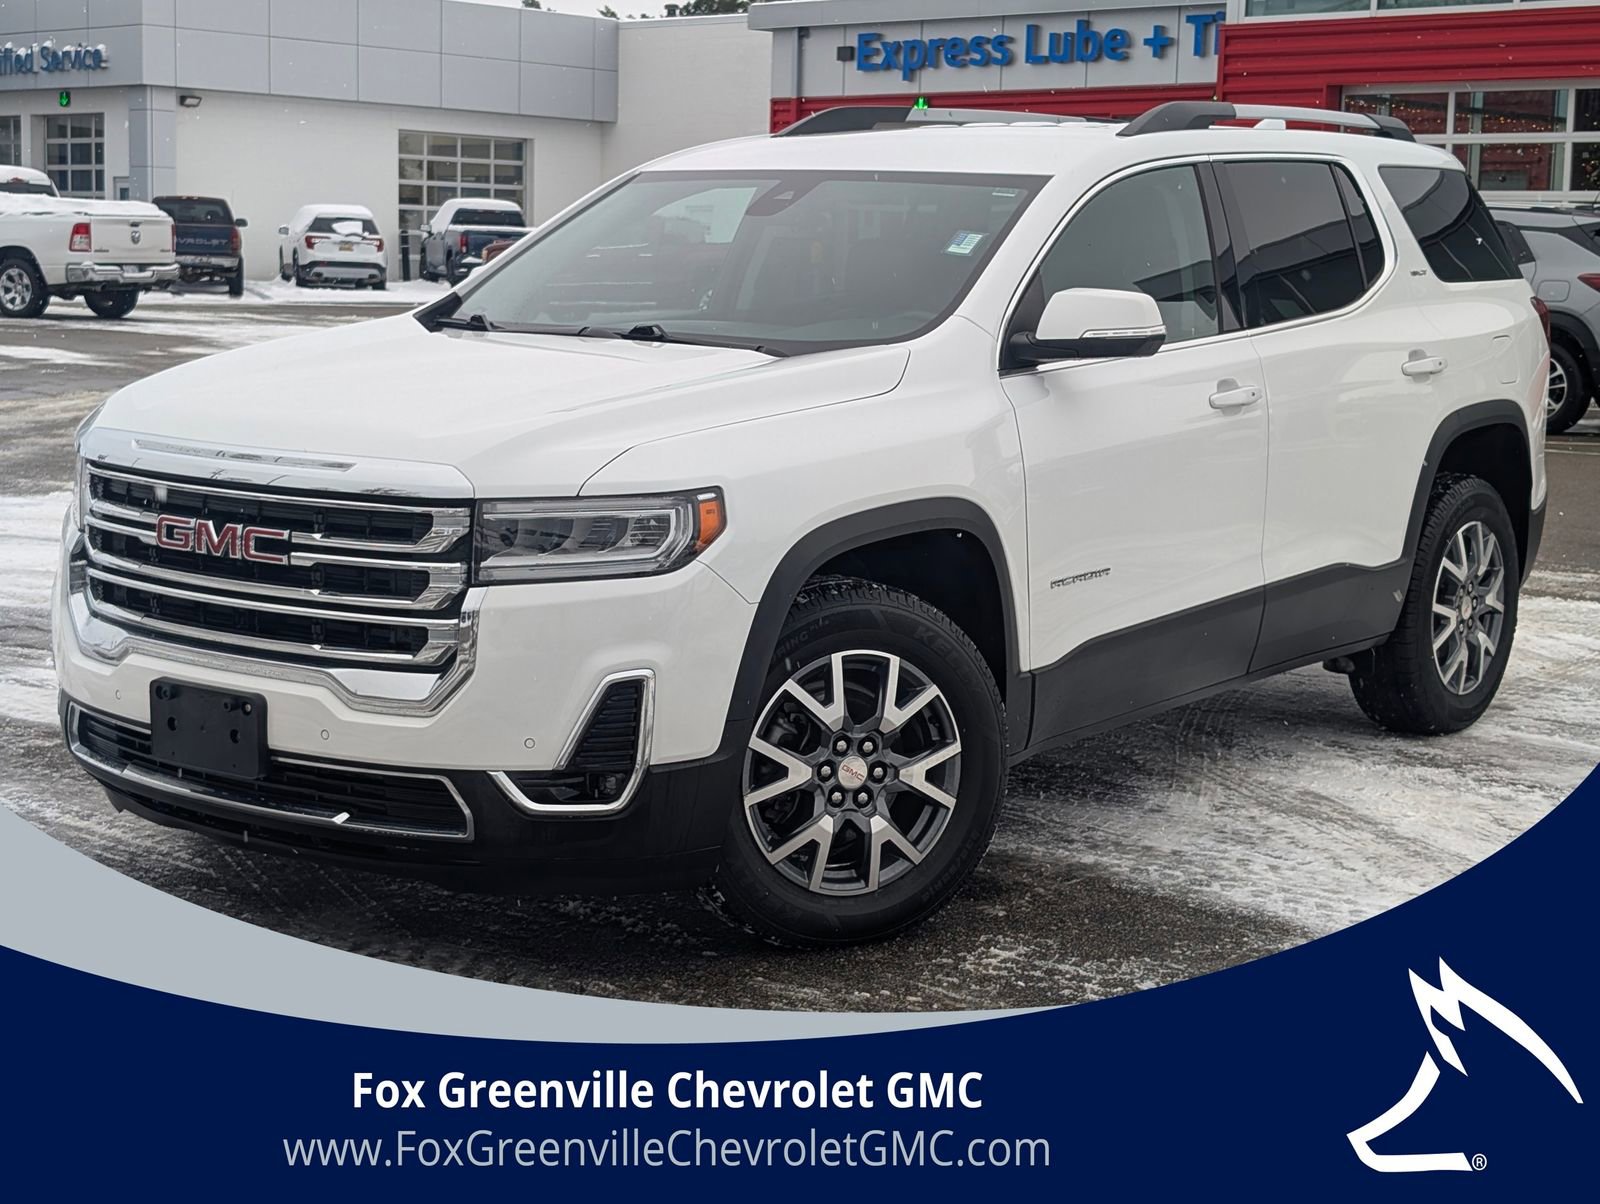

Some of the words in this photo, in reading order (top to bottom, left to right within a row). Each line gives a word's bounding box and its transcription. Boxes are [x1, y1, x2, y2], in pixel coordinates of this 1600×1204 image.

[40, 42, 107, 72] Service
[856, 32, 1012, 81] Express
[1024, 19, 1129, 64] Lube
[1143, 24, 1172, 58] +
[156, 513, 291, 566] GMC
[841, 763, 866, 782] GMC
